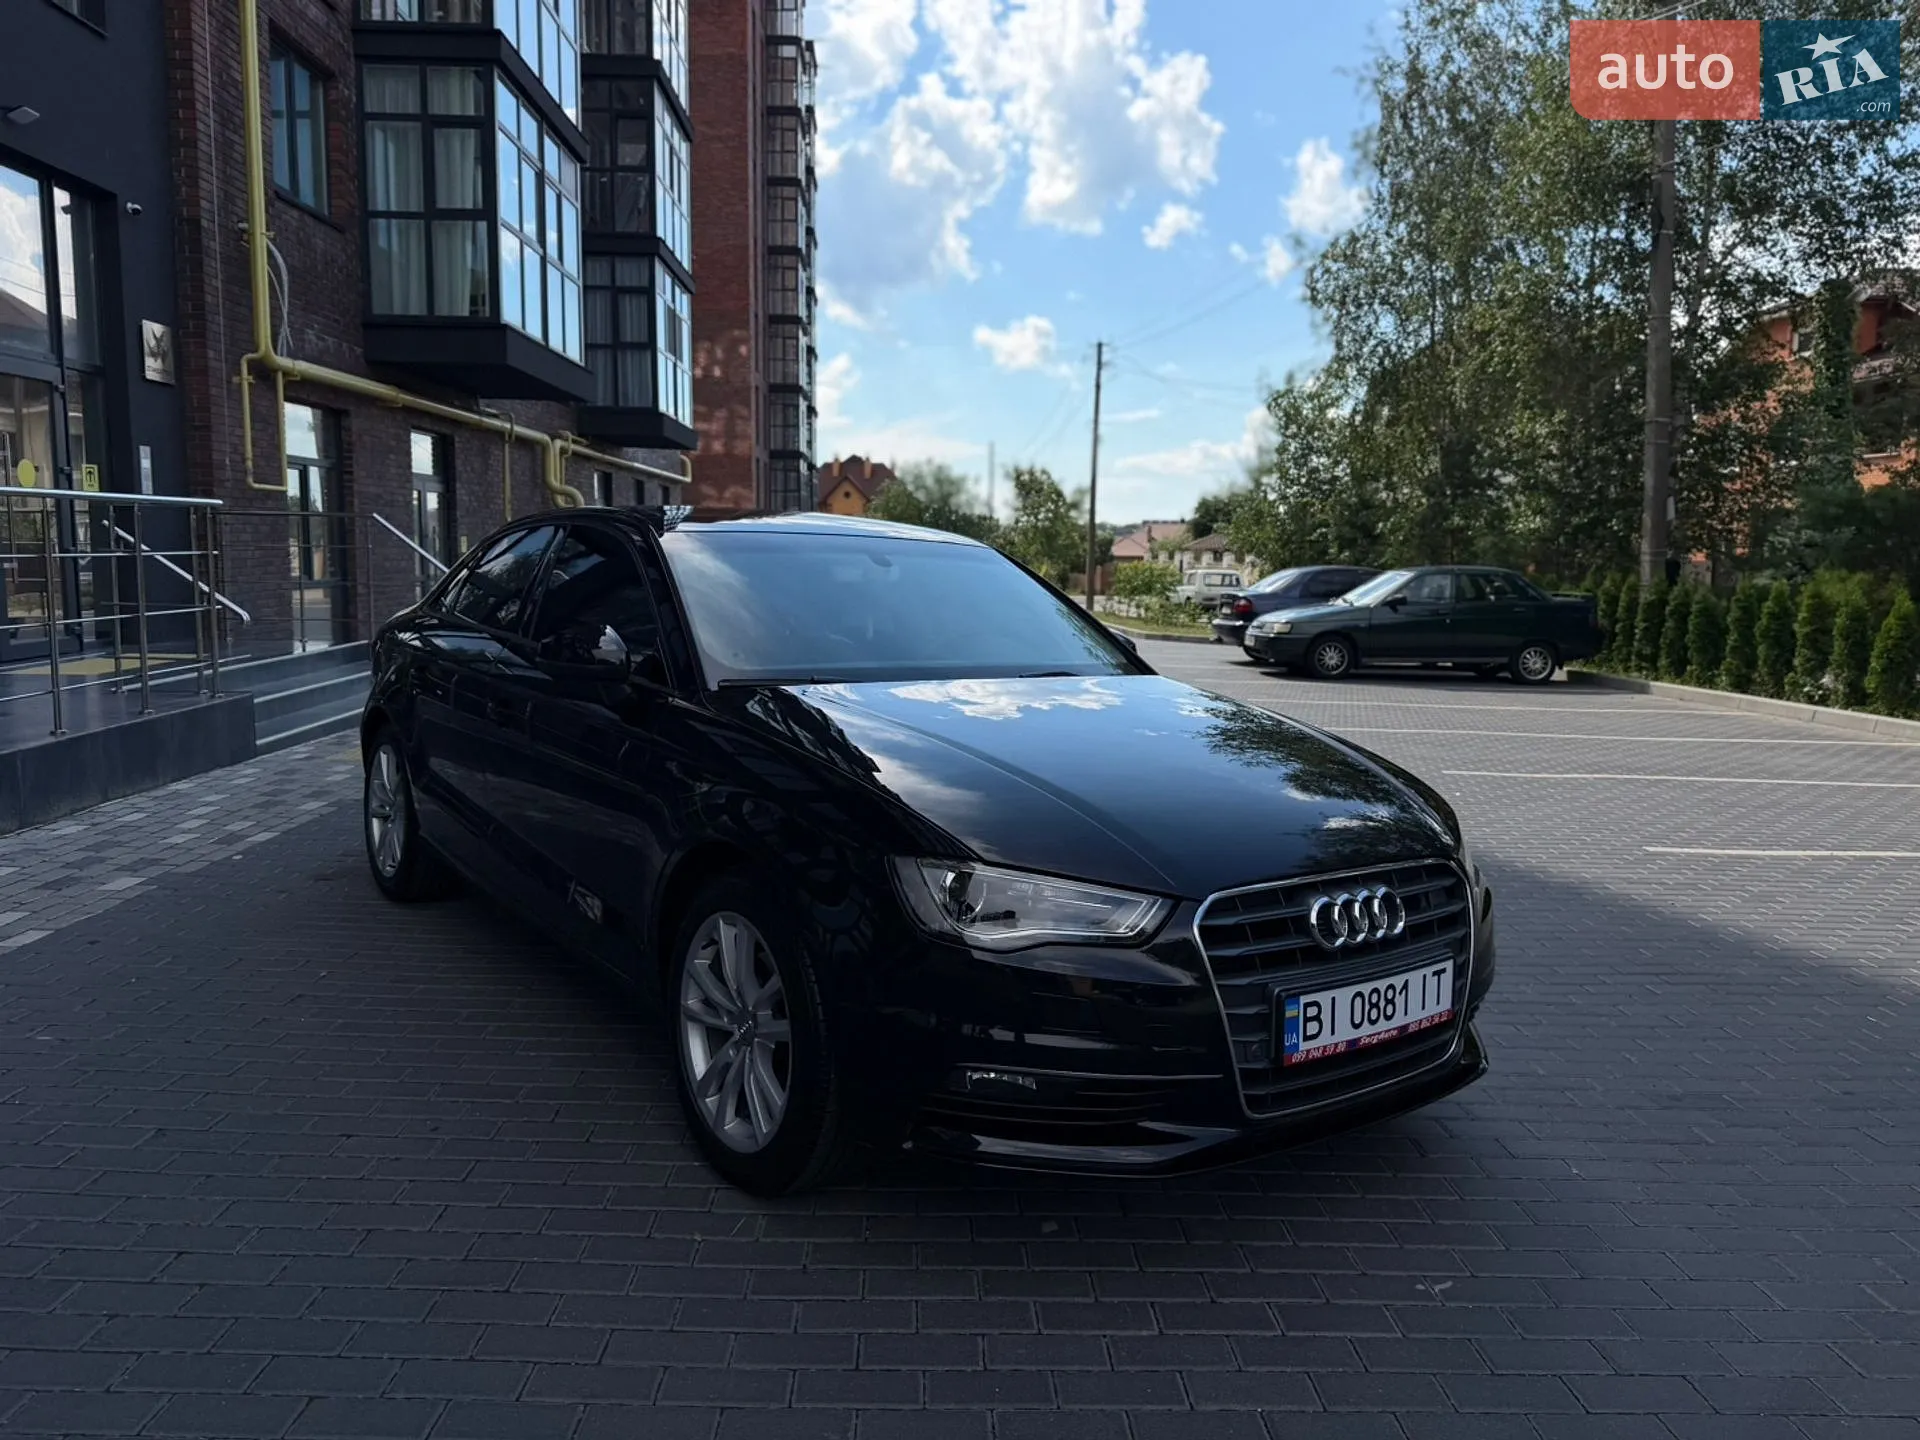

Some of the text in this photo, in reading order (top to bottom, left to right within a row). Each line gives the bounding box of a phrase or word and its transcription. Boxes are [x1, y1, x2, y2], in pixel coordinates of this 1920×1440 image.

[1302, 996, 1336, 1043] BI
[1350, 978, 1409, 1030] 0881
[1421, 967, 1447, 1011] IT
[1284, 1033, 1298, 1046] UA
